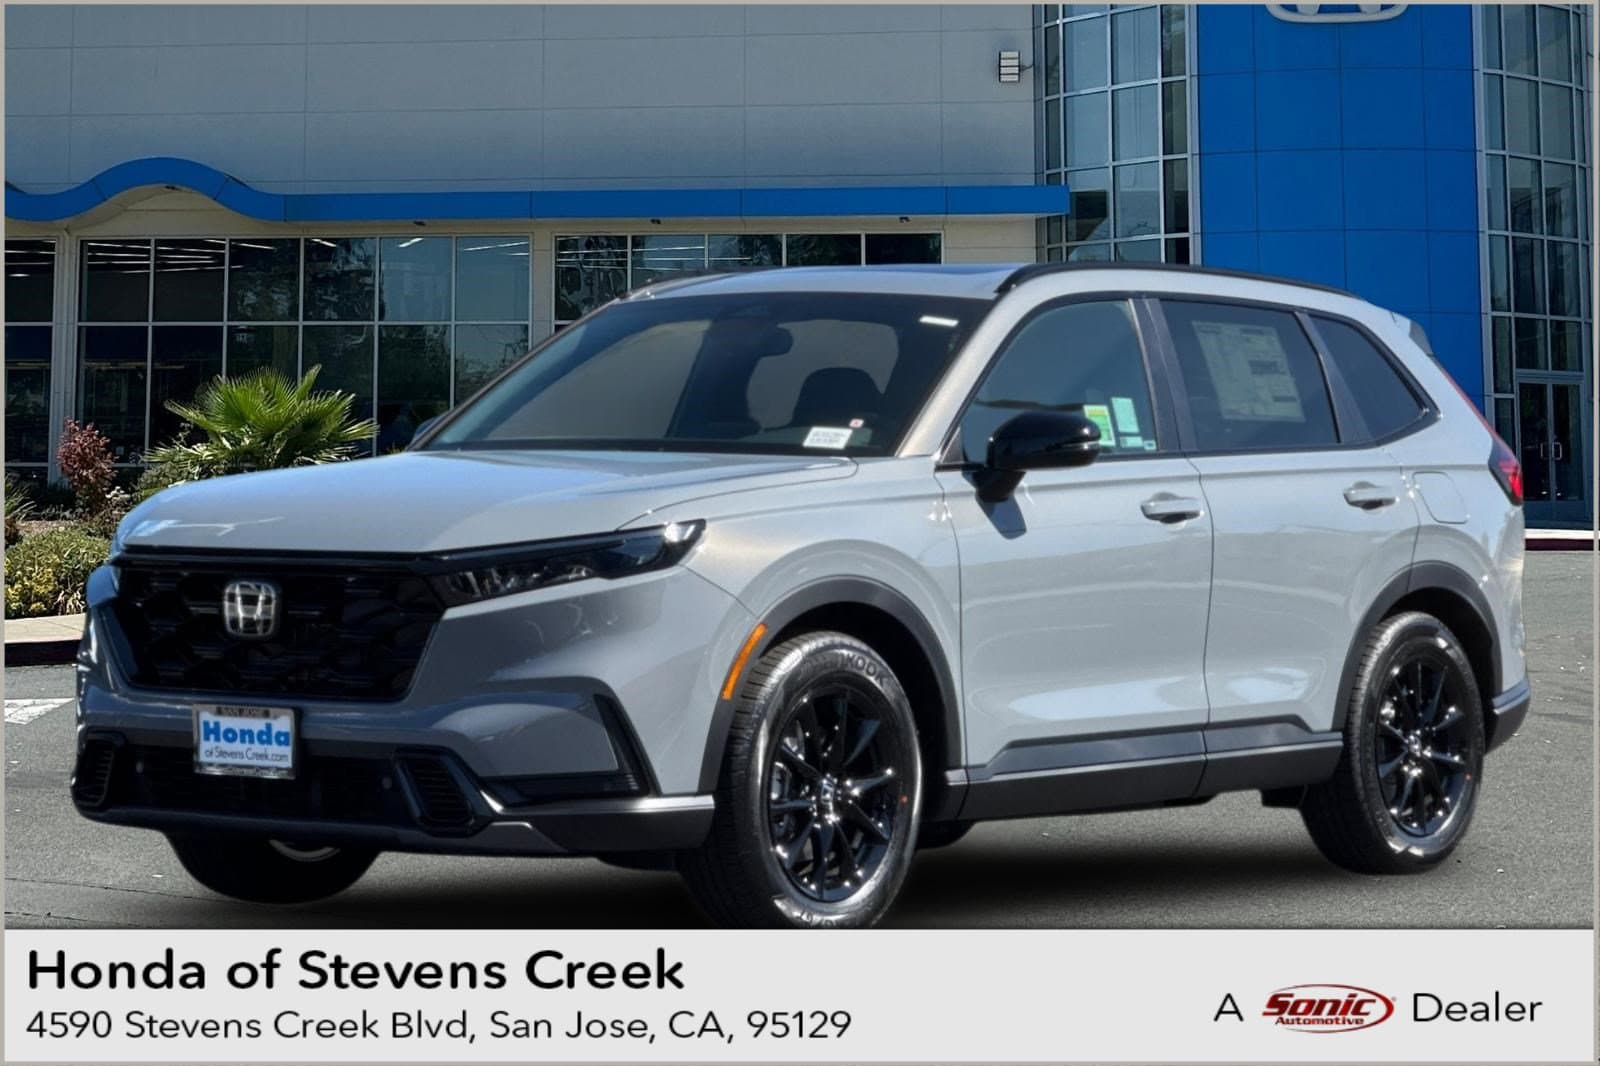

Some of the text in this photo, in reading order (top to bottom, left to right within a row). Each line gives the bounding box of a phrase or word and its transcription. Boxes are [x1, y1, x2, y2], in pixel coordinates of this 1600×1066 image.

[203, 720, 290, 746] Honda
[204, 748, 214, 758] of
[215, 746, 244, 760] Stevens
